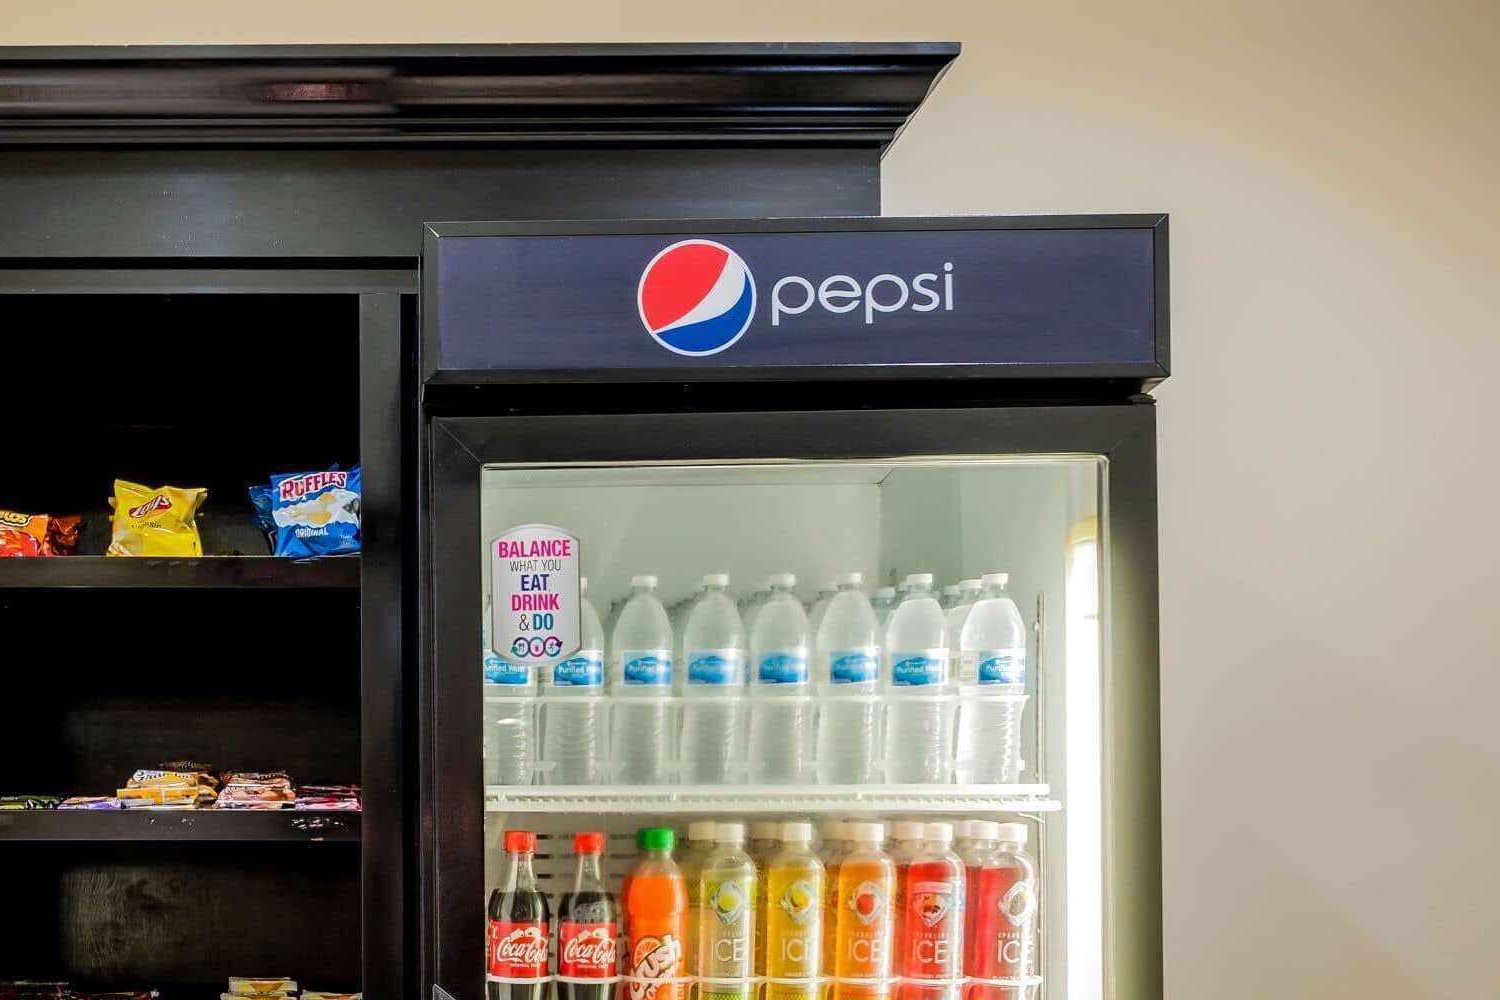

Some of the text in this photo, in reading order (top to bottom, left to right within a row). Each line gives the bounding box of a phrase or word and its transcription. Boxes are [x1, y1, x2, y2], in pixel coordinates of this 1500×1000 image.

[771, 262, 954, 326] pepsi
[295, 527, 329, 538] ORIGINAL
[498, 540, 571, 558] BALANCE
[510, 560, 561, 572] WHAT YOU
[521, 574, 549, 591] EAT
[511, 594, 560, 611] DRINK
[532, 613, 553, 630] DO
[711, 938, 747, 962] ICE
[912, 939, 949, 964] ICE
